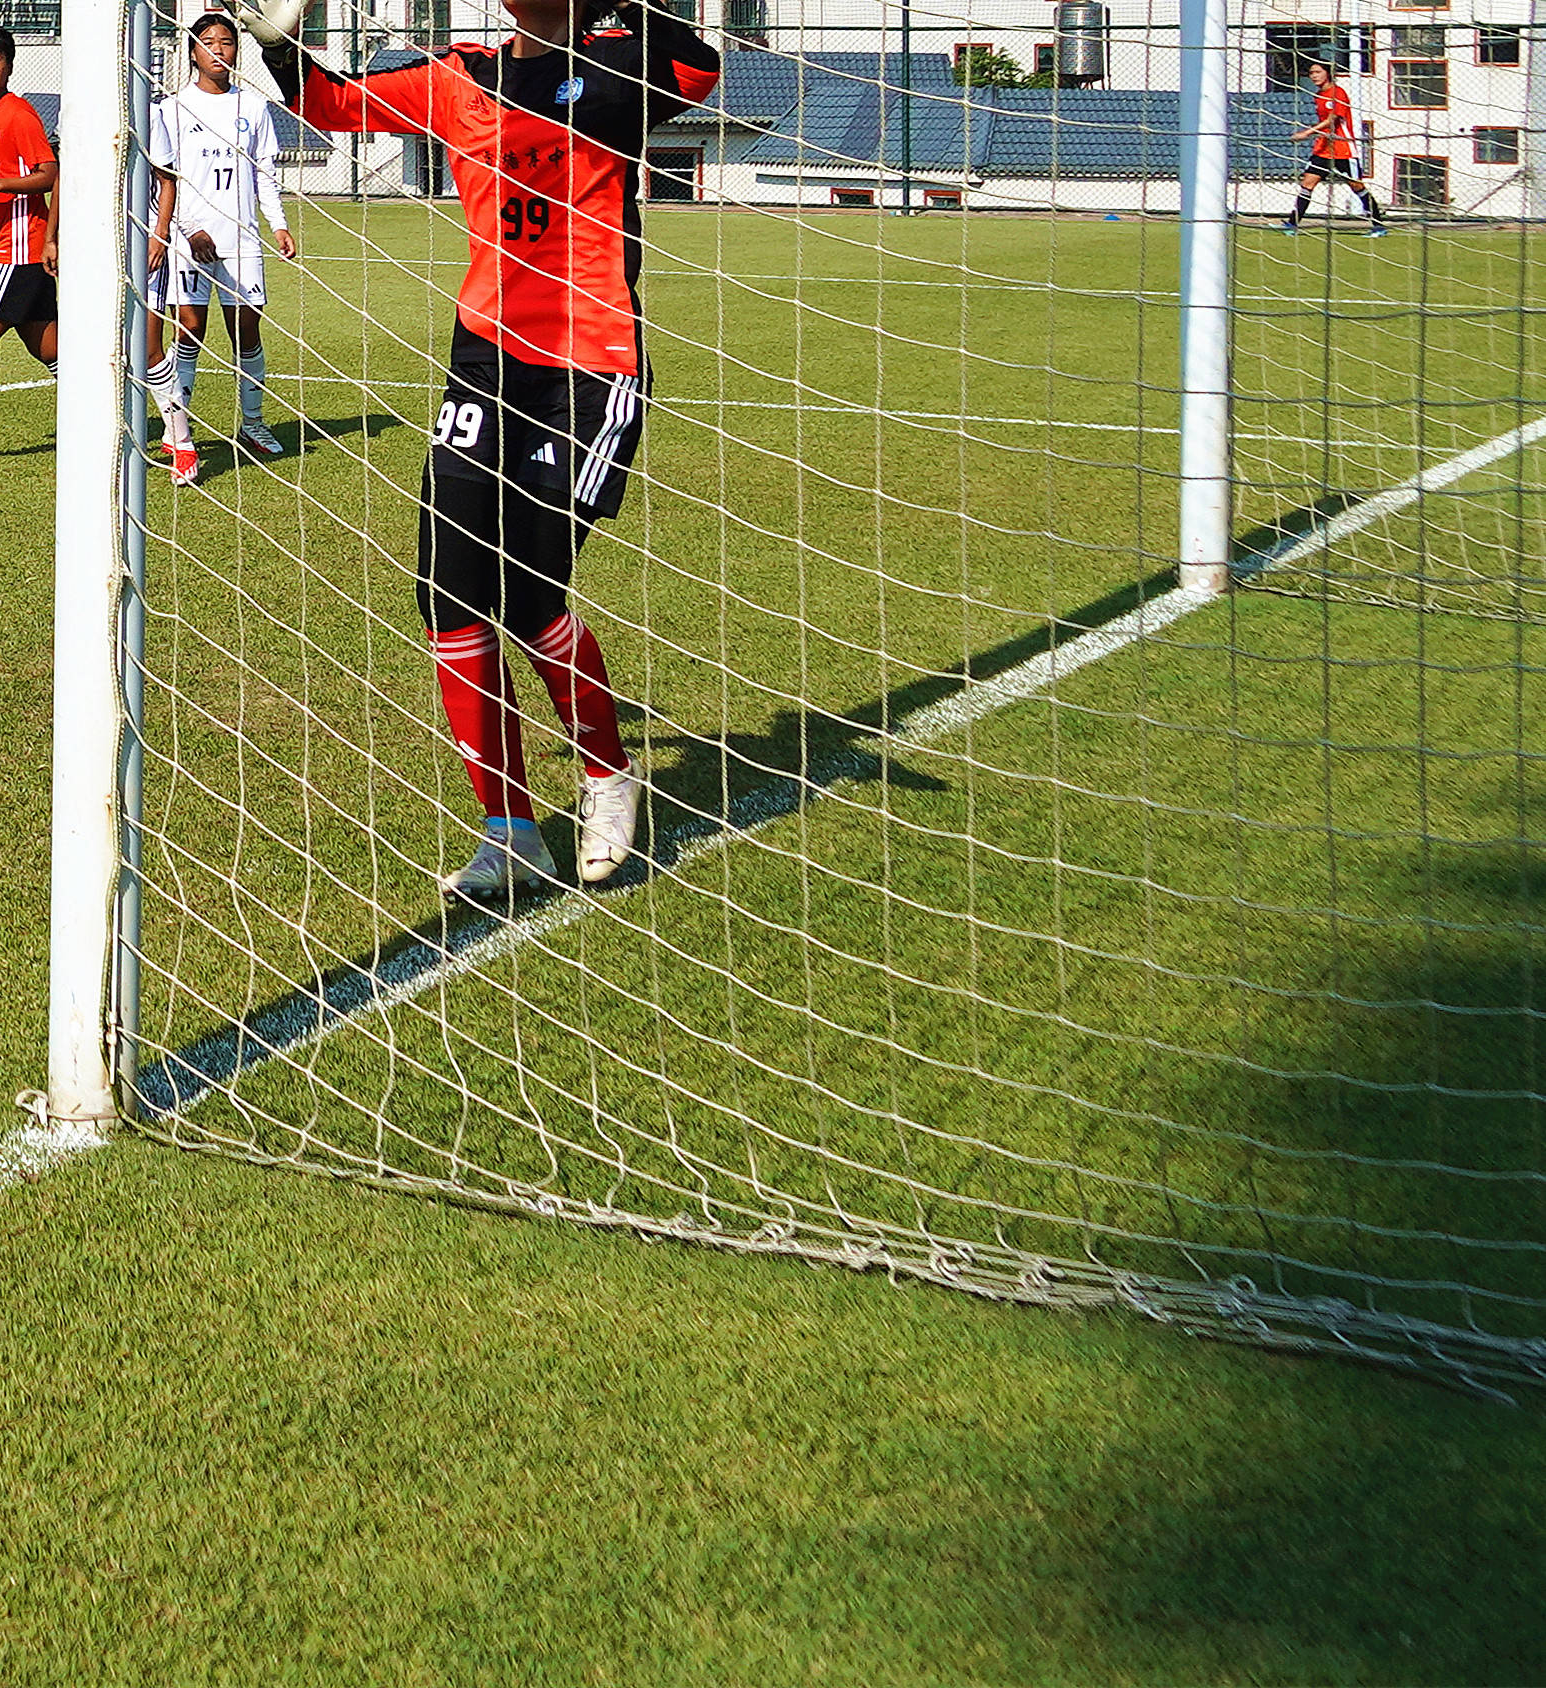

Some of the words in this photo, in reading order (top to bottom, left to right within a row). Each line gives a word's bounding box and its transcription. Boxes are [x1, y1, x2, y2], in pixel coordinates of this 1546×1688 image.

[214, 168, 233, 191] 17
[500, 196, 550, 243] 99
[179, 269, 199, 294] 17
[435, 400, 484, 448] 99
